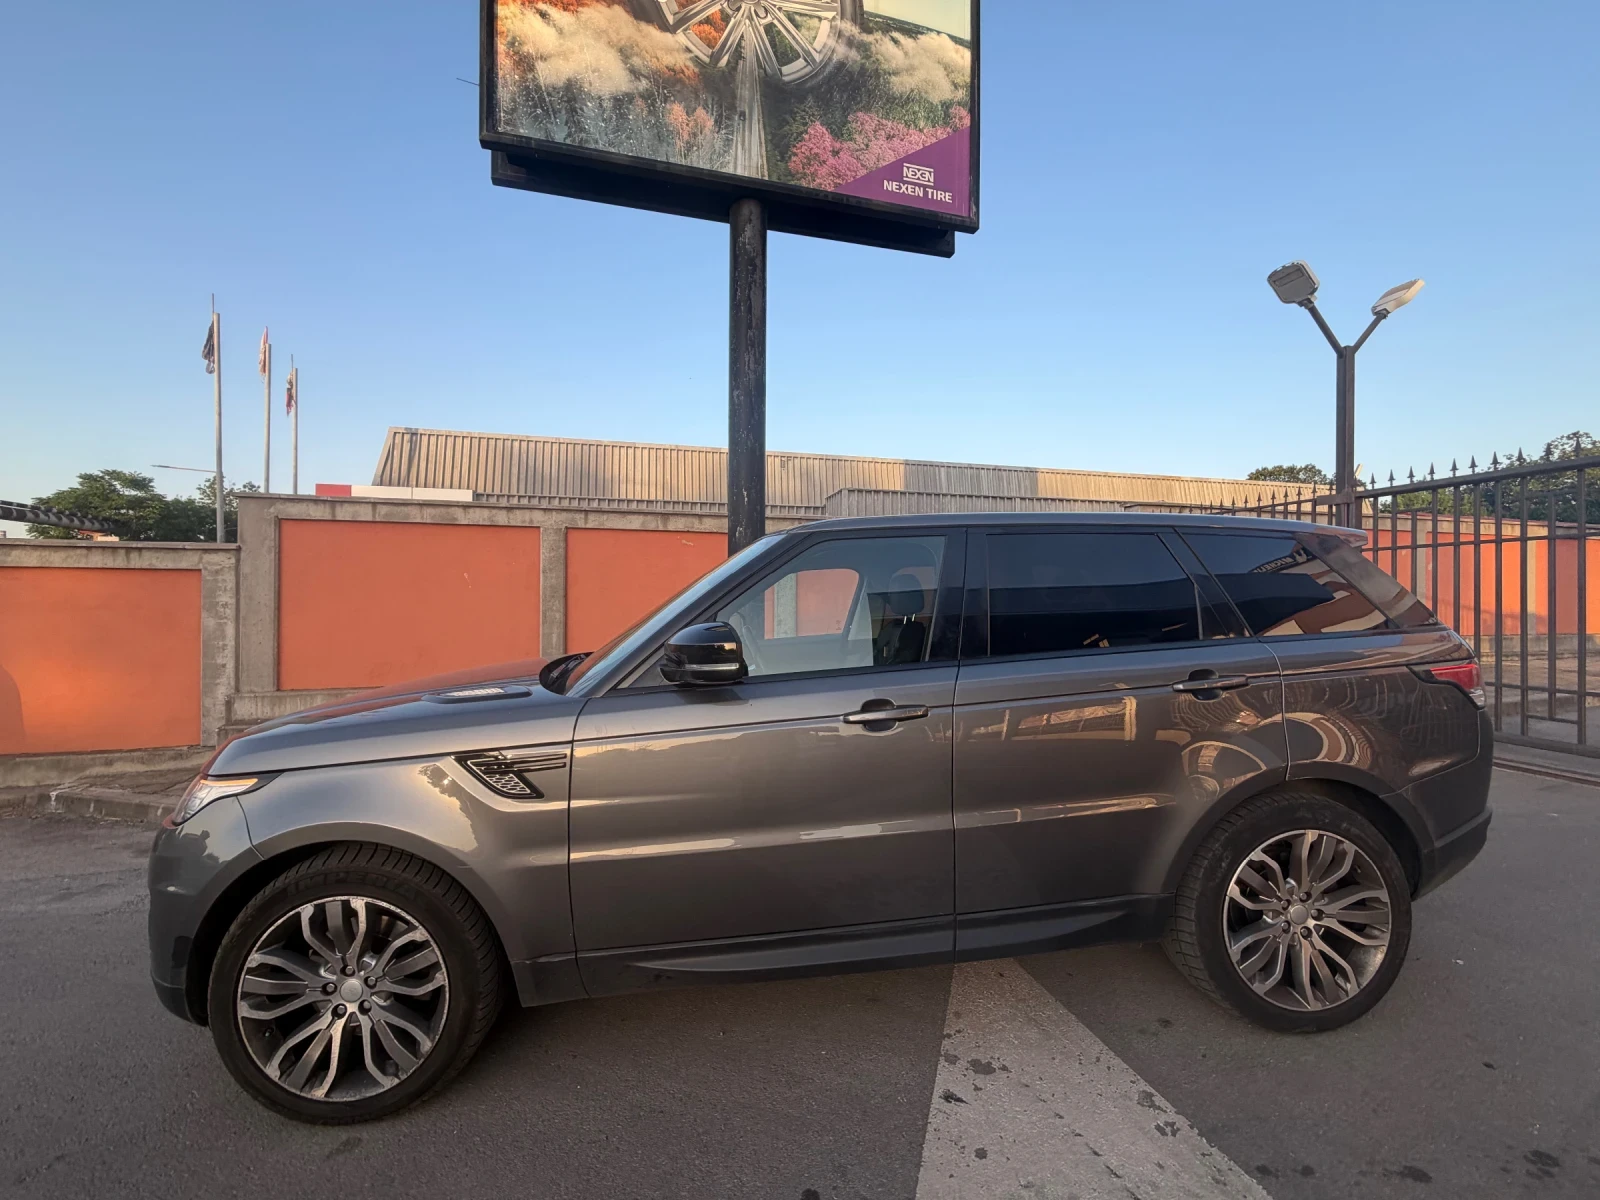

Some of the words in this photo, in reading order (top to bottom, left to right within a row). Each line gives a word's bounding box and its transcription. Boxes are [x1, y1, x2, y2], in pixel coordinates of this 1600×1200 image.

[903, 165, 934, 183] NEXEN
[883, 179, 924, 198] NEXEN
[925, 188, 953, 203] TIRE
